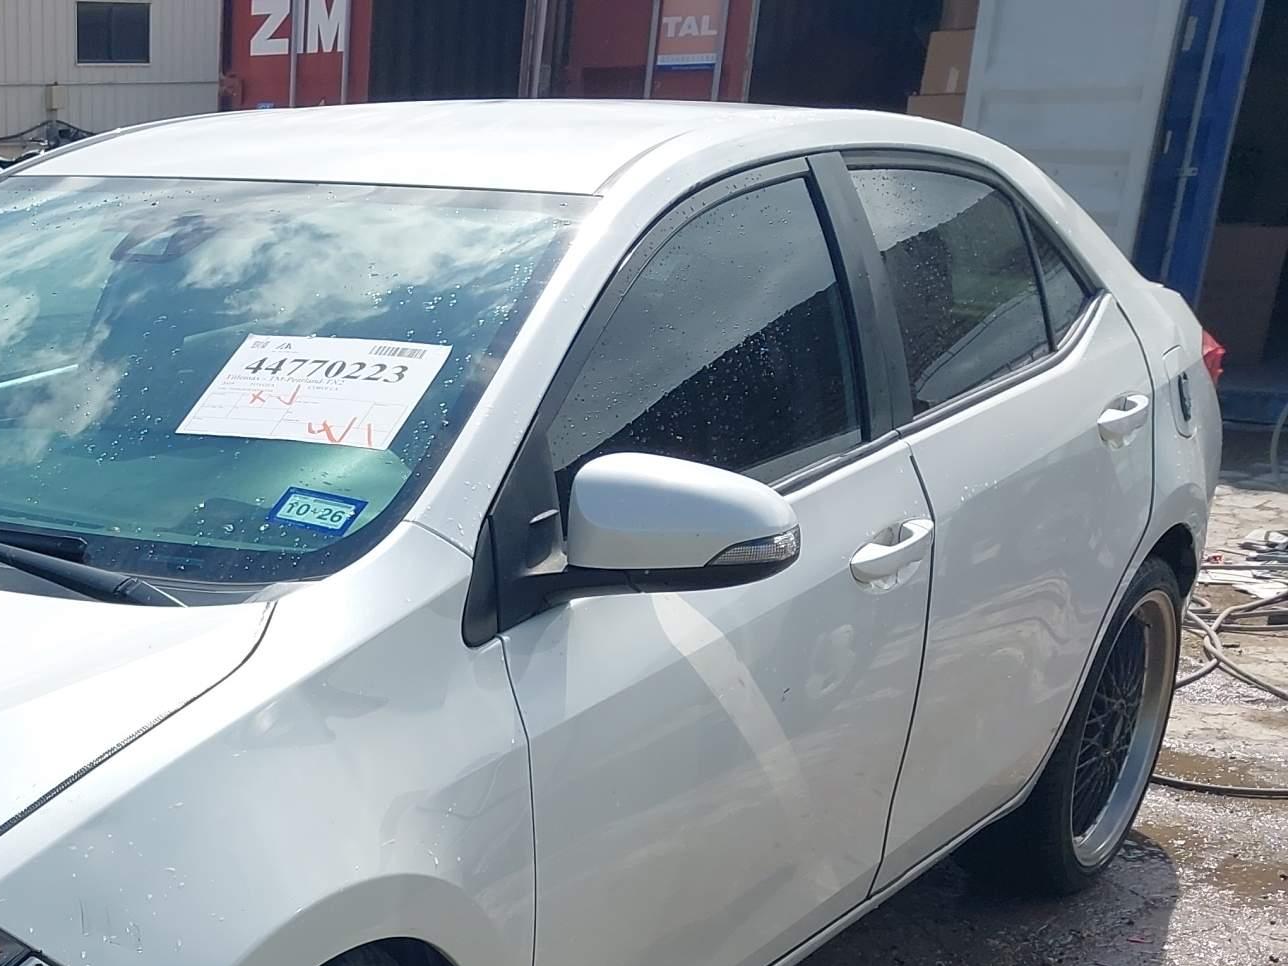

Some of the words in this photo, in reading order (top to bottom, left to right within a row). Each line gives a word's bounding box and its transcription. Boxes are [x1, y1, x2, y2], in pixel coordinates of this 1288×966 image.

[250, 0, 346, 56] ZIM
[662, 15, 718, 37] TAL
[245, 356, 409, 384] 44770223
